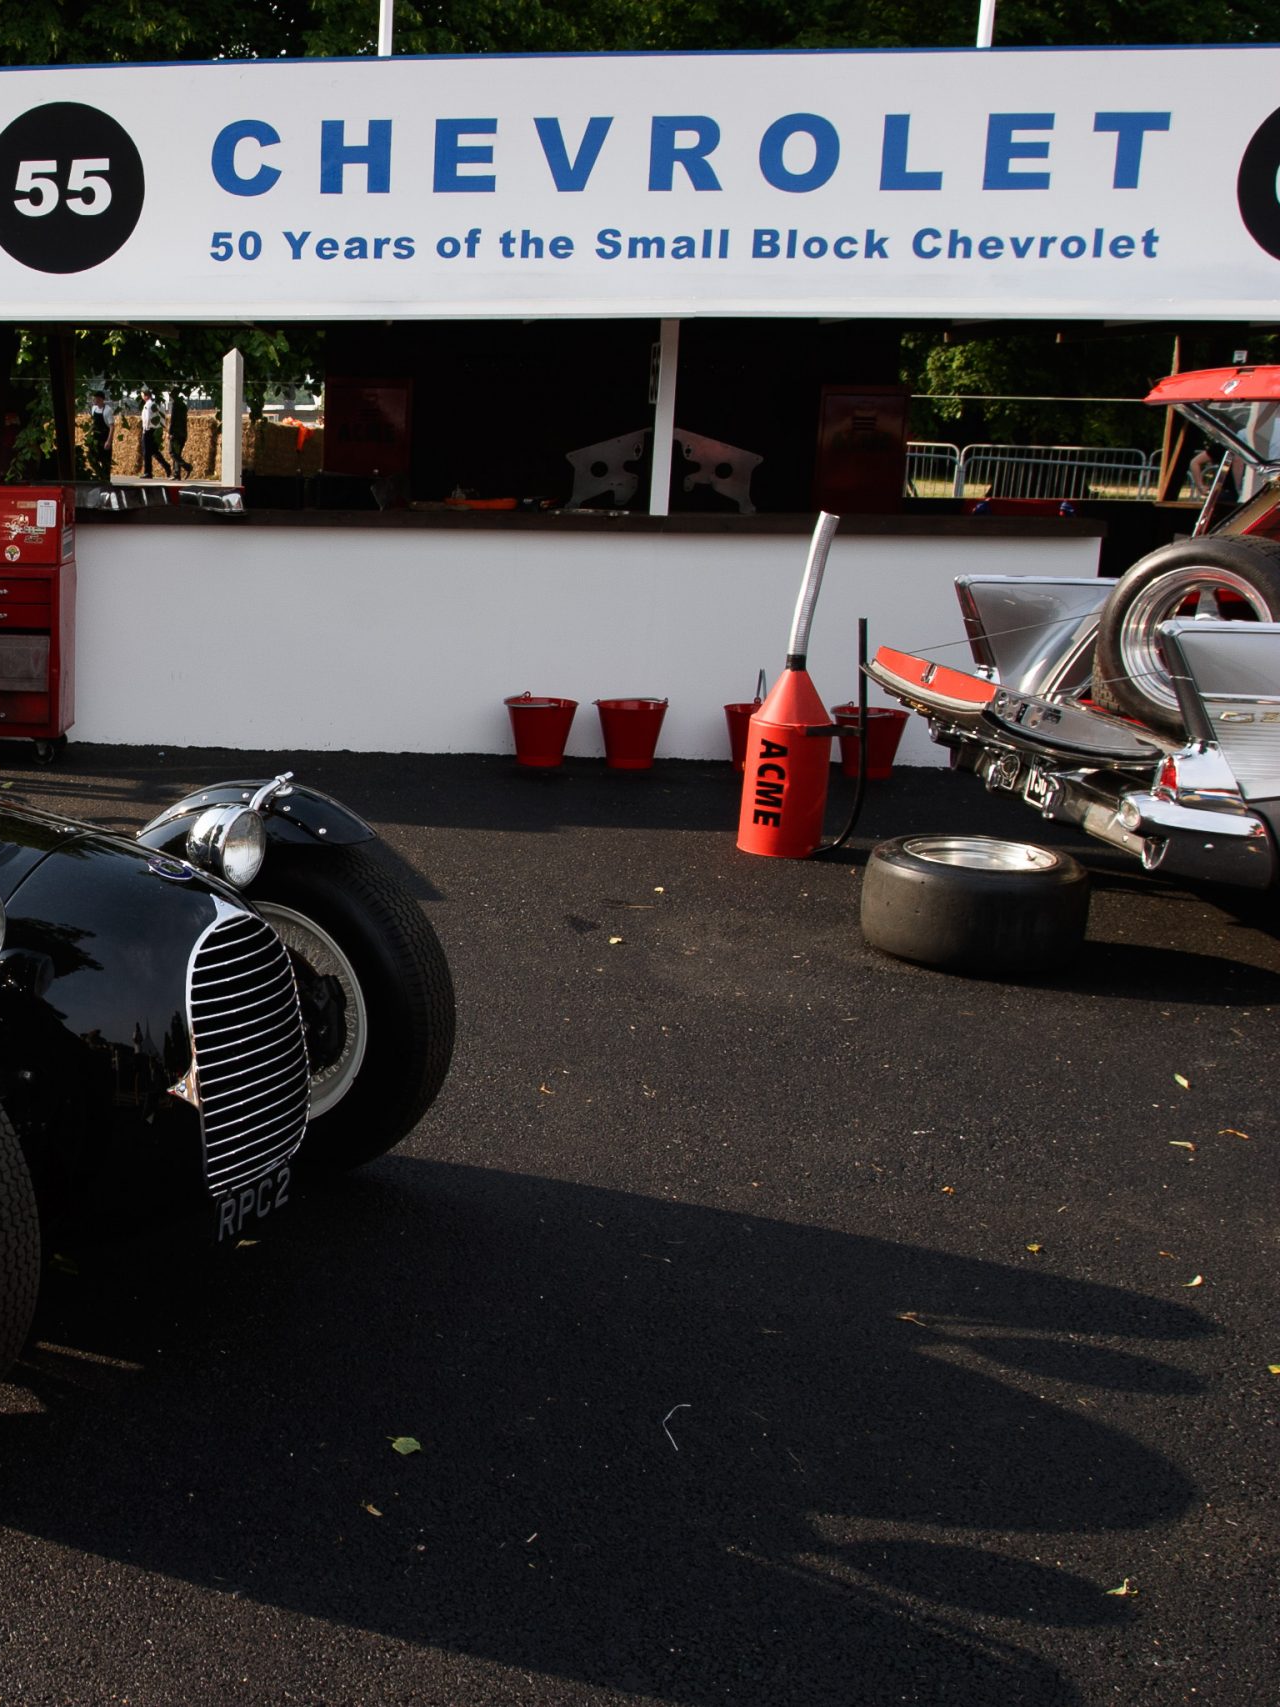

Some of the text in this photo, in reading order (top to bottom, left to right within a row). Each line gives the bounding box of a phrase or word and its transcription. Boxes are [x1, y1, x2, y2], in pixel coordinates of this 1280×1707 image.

[13, 158, 112, 217] 55
[211, 112, 1172, 197] CHEVROLET
[210, 227, 1160, 261] 50 Years of the Small Block Chevrolet
[753, 738, 788, 829] ACME
